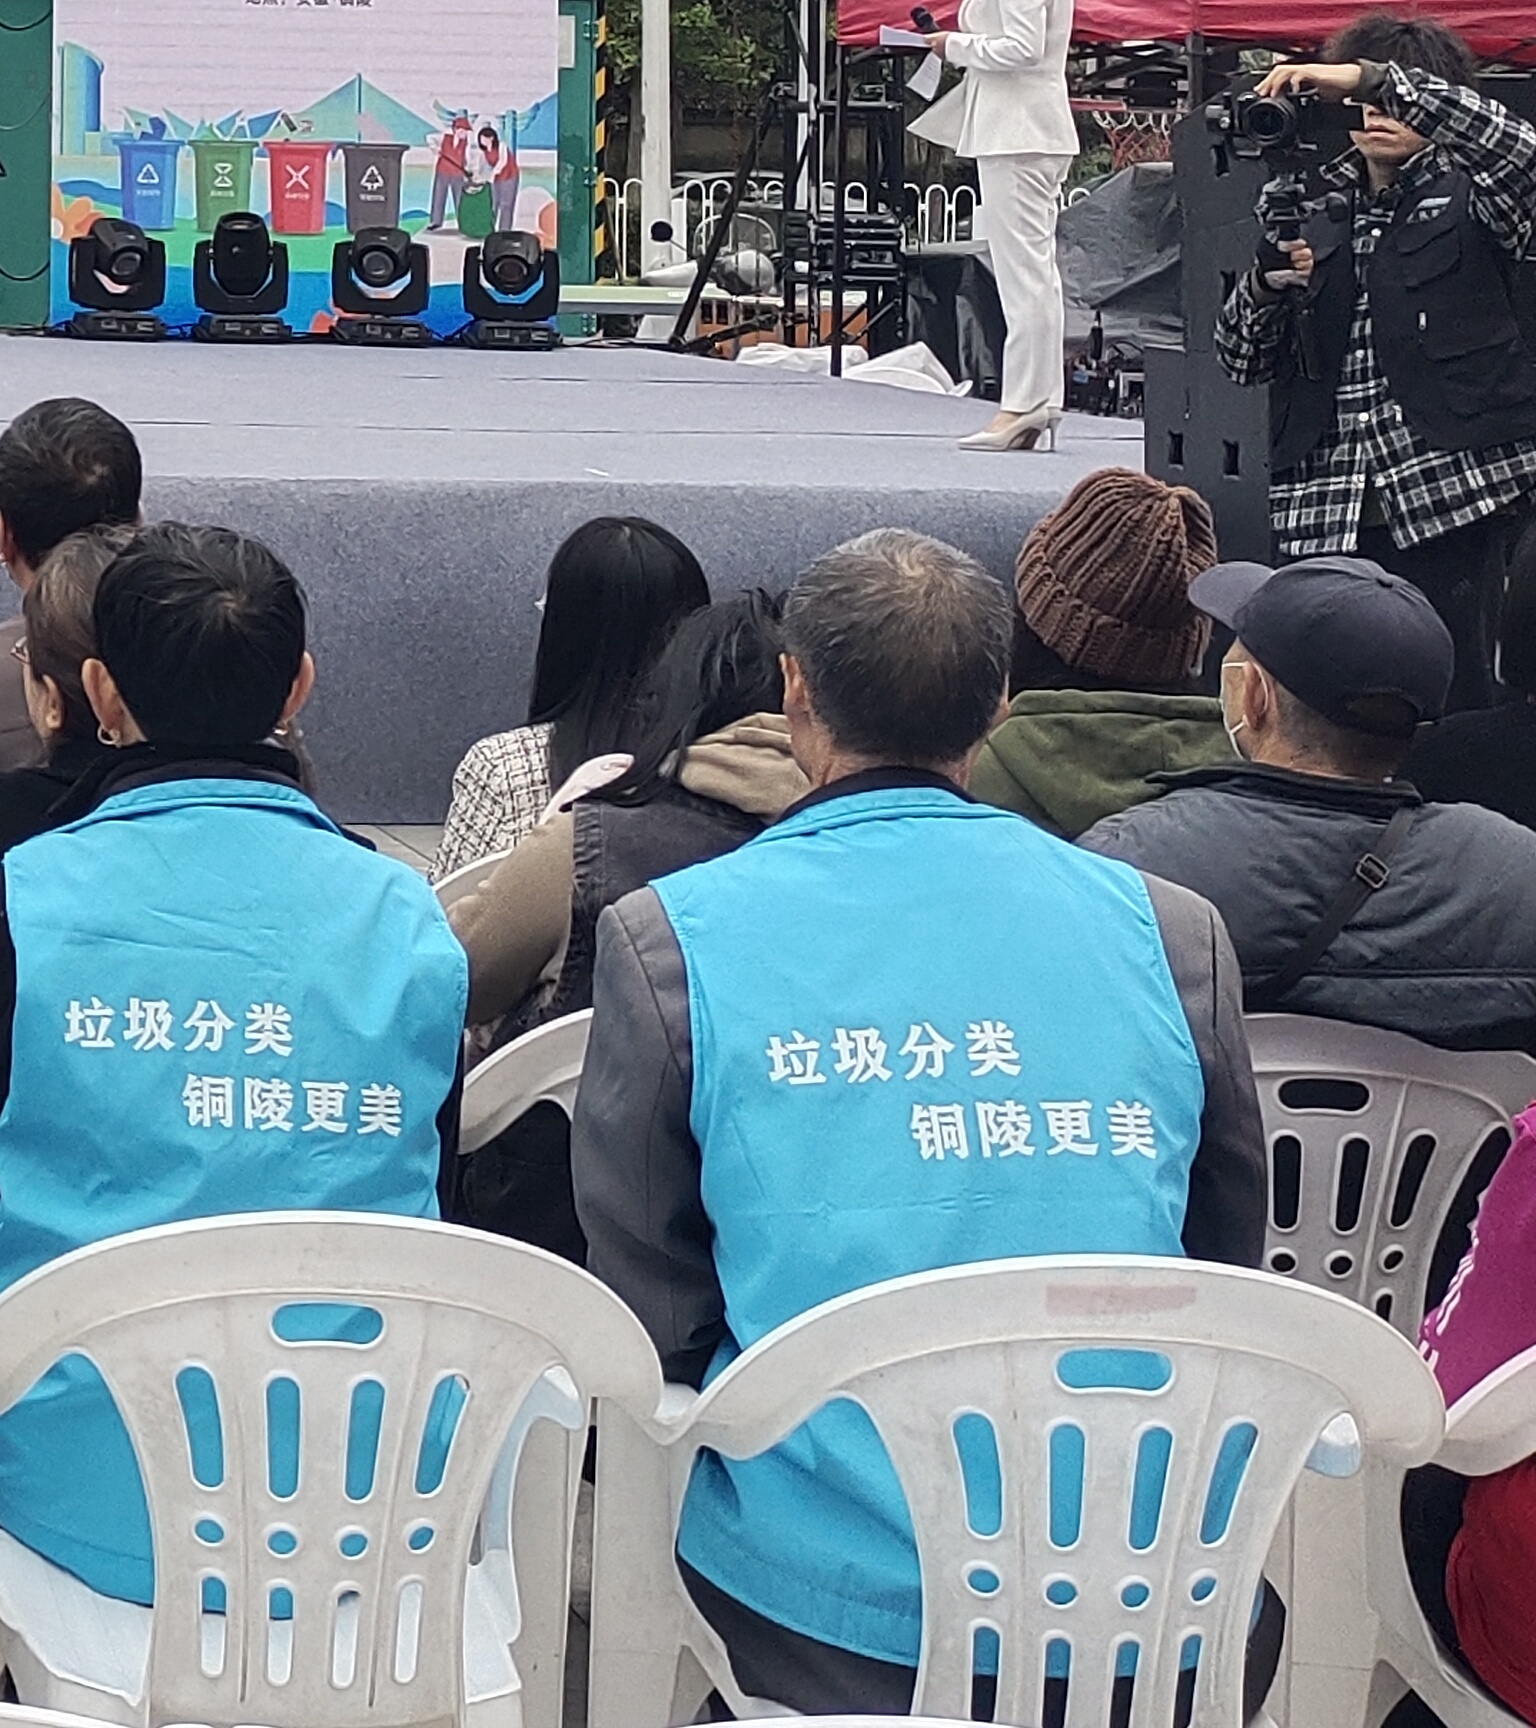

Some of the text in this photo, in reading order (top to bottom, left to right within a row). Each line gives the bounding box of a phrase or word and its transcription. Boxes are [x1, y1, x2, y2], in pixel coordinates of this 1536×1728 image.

[64, 997, 294, 1056] 垃圾分类
[766, 1020, 1023, 1086] 垃圾分类
[182, 1073, 403, 1136] 铜陵更美
[909, 1100, 1158, 1161] 铜陵更美
